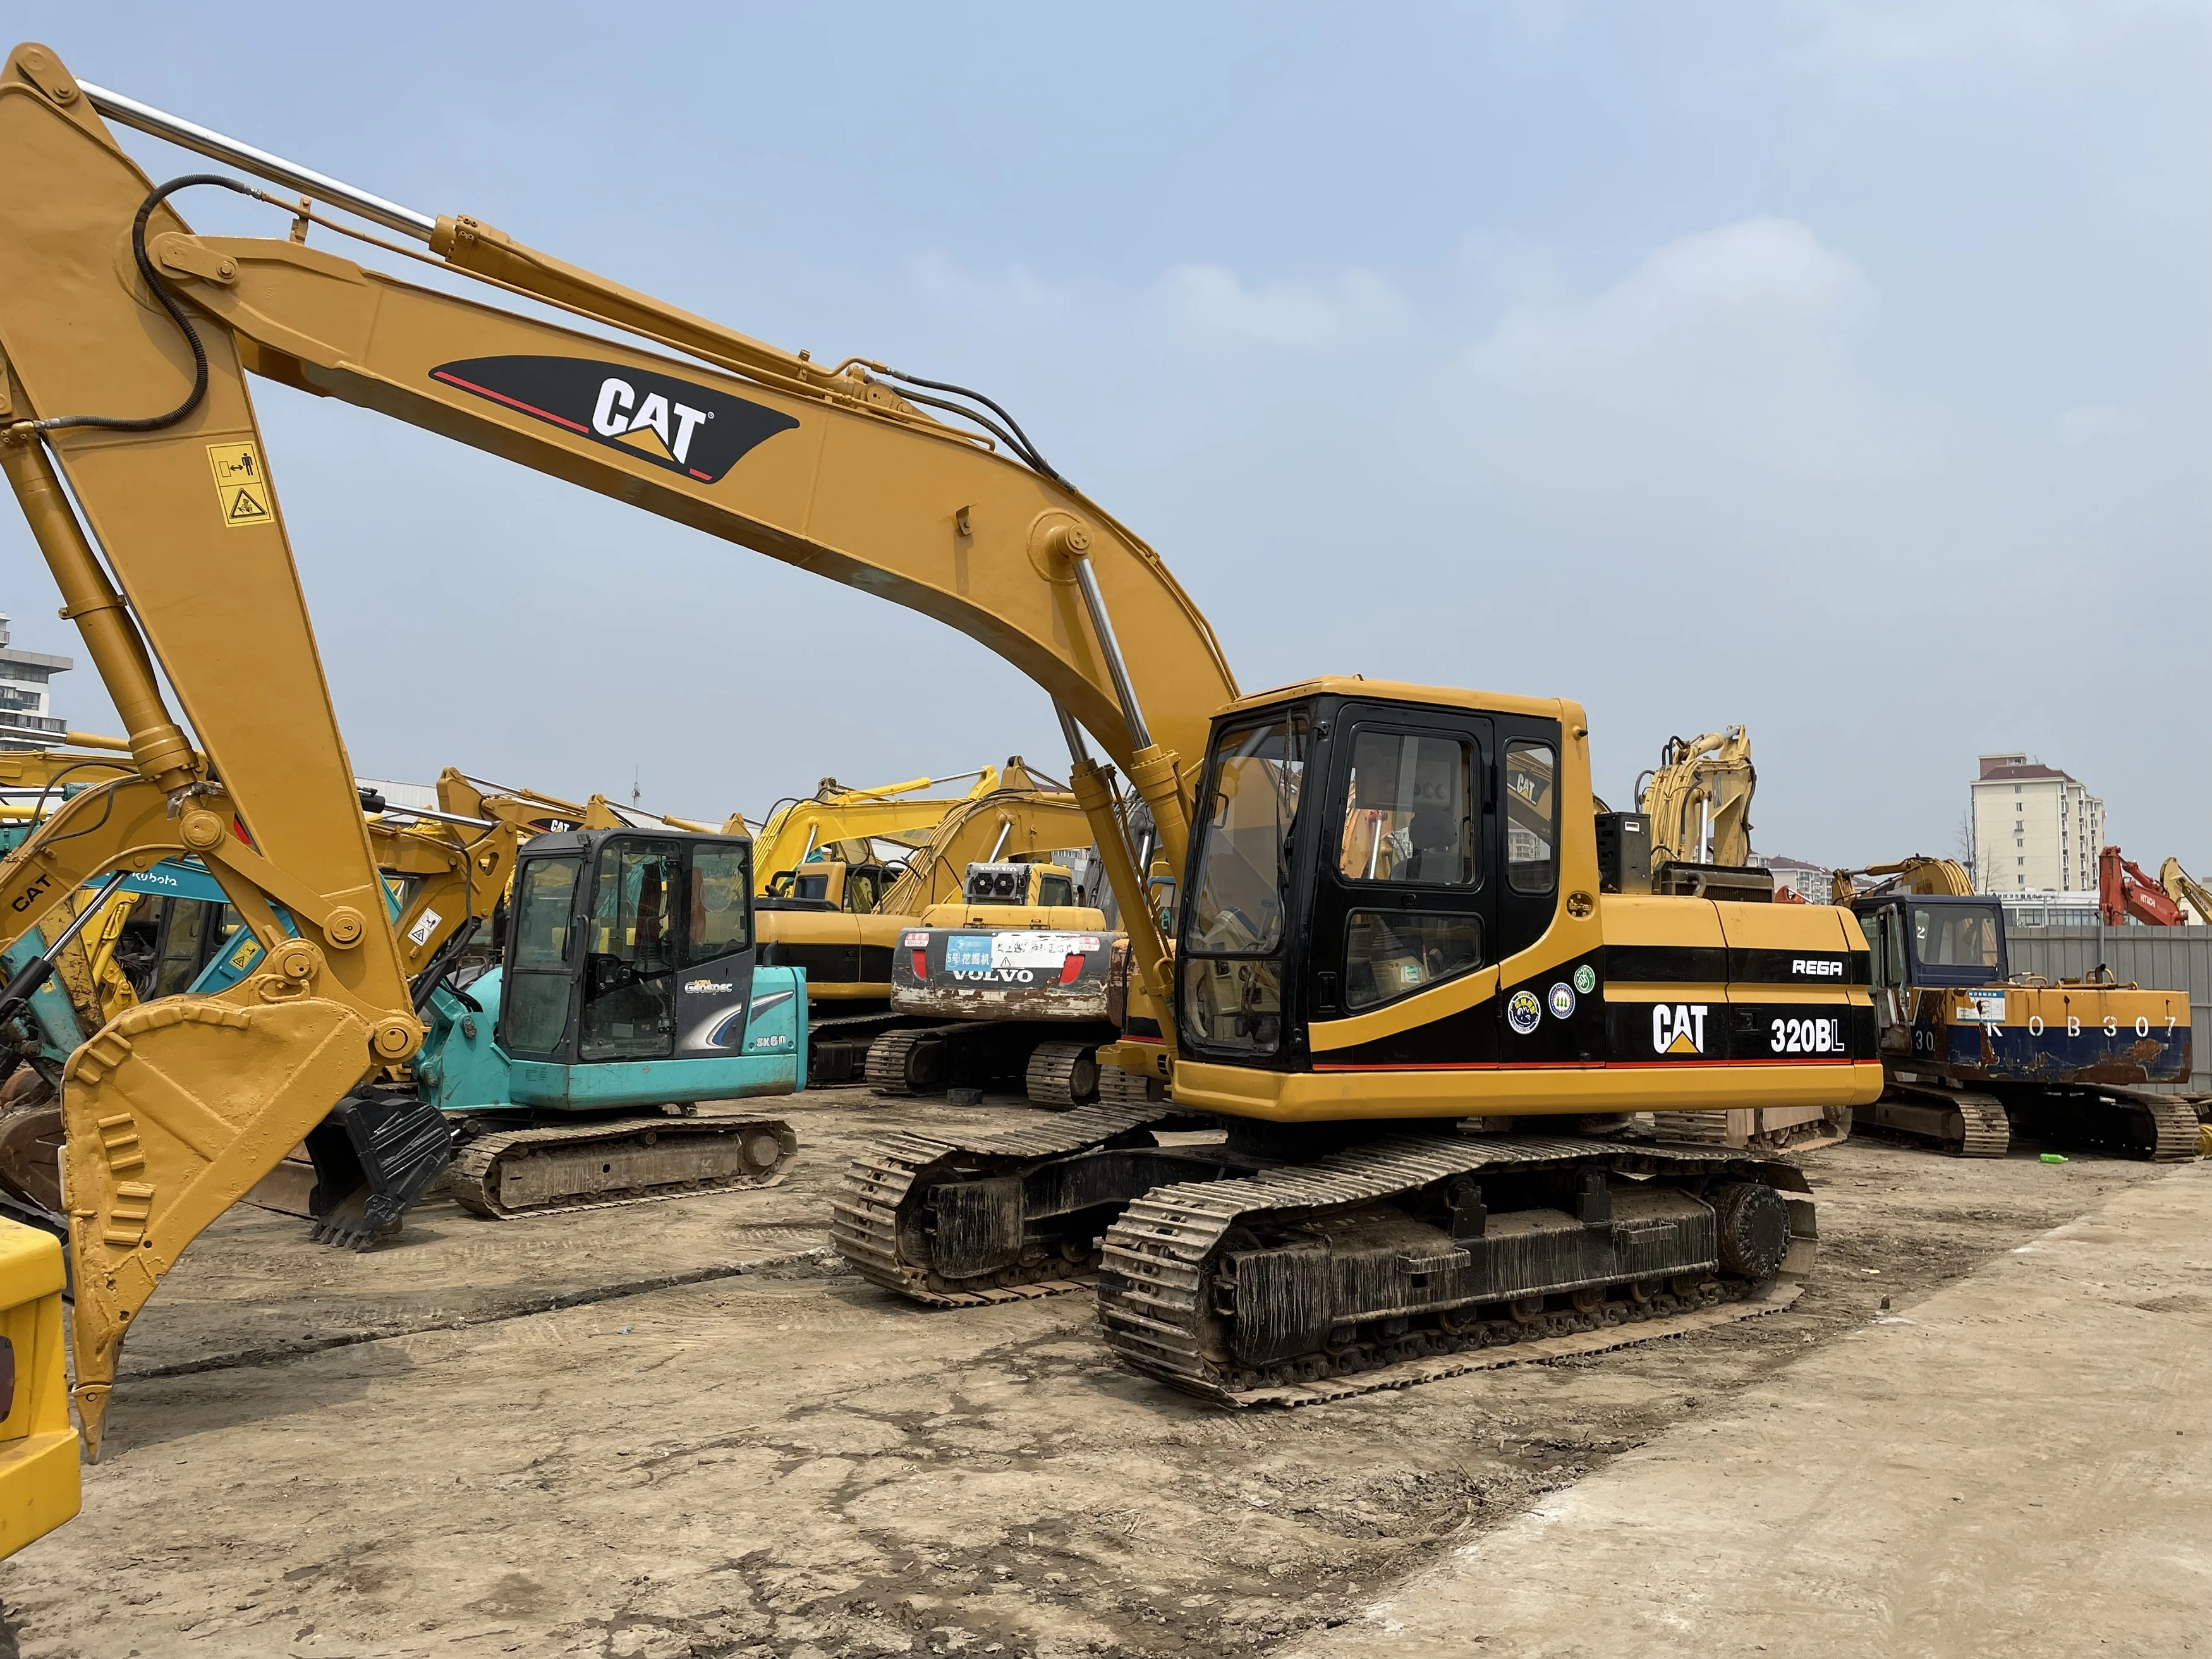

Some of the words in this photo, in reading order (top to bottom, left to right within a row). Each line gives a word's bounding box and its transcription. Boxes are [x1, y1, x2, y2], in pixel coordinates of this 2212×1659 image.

[592, 377, 707, 465] CAT
[1517, 773, 1535, 801] CAT
[550, 819, 570, 832] CAT
[11, 873, 51, 913] CAT
[1917, 926, 1925, 939] 2
[962, 952, 990, 966] 挖掘机
[1792, 959, 1842, 976] REGA
[952, 969, 1034, 983] VOLVO
[1653, 1004, 1708, 1054] CAT
[1770, 1018, 1845, 1052] 320BL
